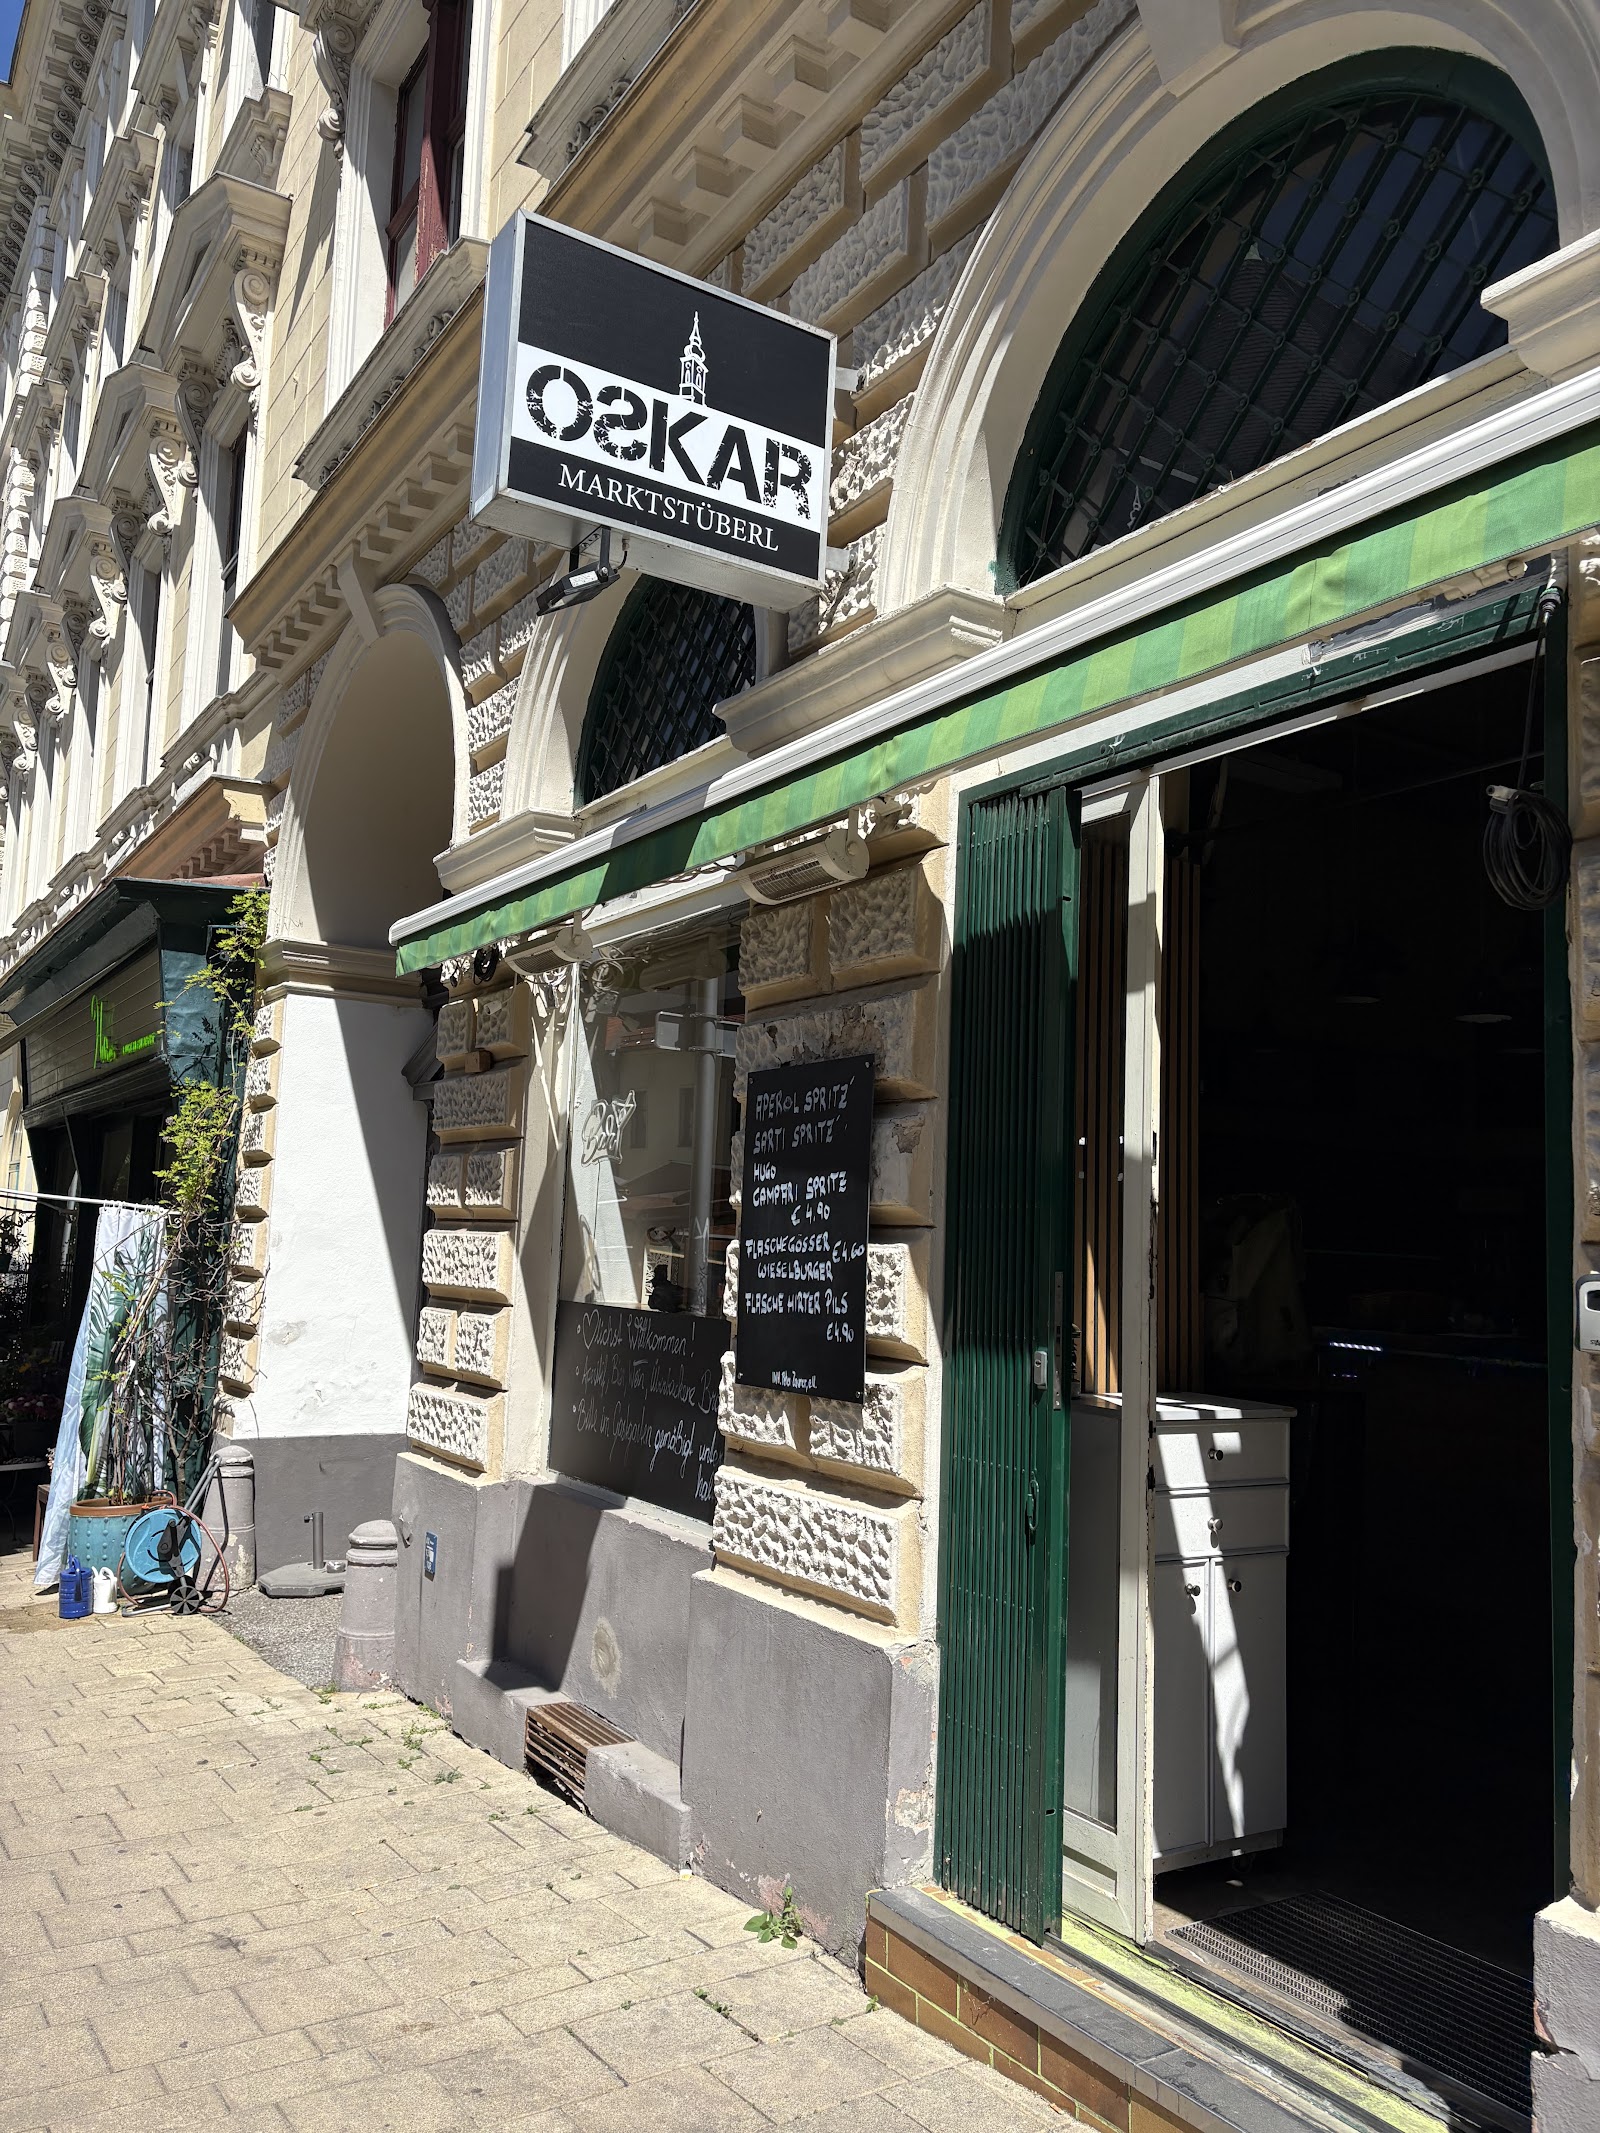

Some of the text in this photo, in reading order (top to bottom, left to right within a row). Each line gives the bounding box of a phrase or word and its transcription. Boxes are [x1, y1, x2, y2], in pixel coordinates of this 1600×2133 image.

[526, 364, 812, 520] OSKAR
[558, 463, 780, 552] MARKTSTÜBERL
[755, 1089, 800, 1121] APEROL
[753, 1127, 786, 1155] SARTI
[753, 1161, 777, 1182] HUGO
[753, 1170, 847, 1207] CAMPARI SPRITZ
[757, 1260, 834, 1282] WIESELBURGER
[745, 1288, 848, 1315] FLASCHE HIRTER PILS
